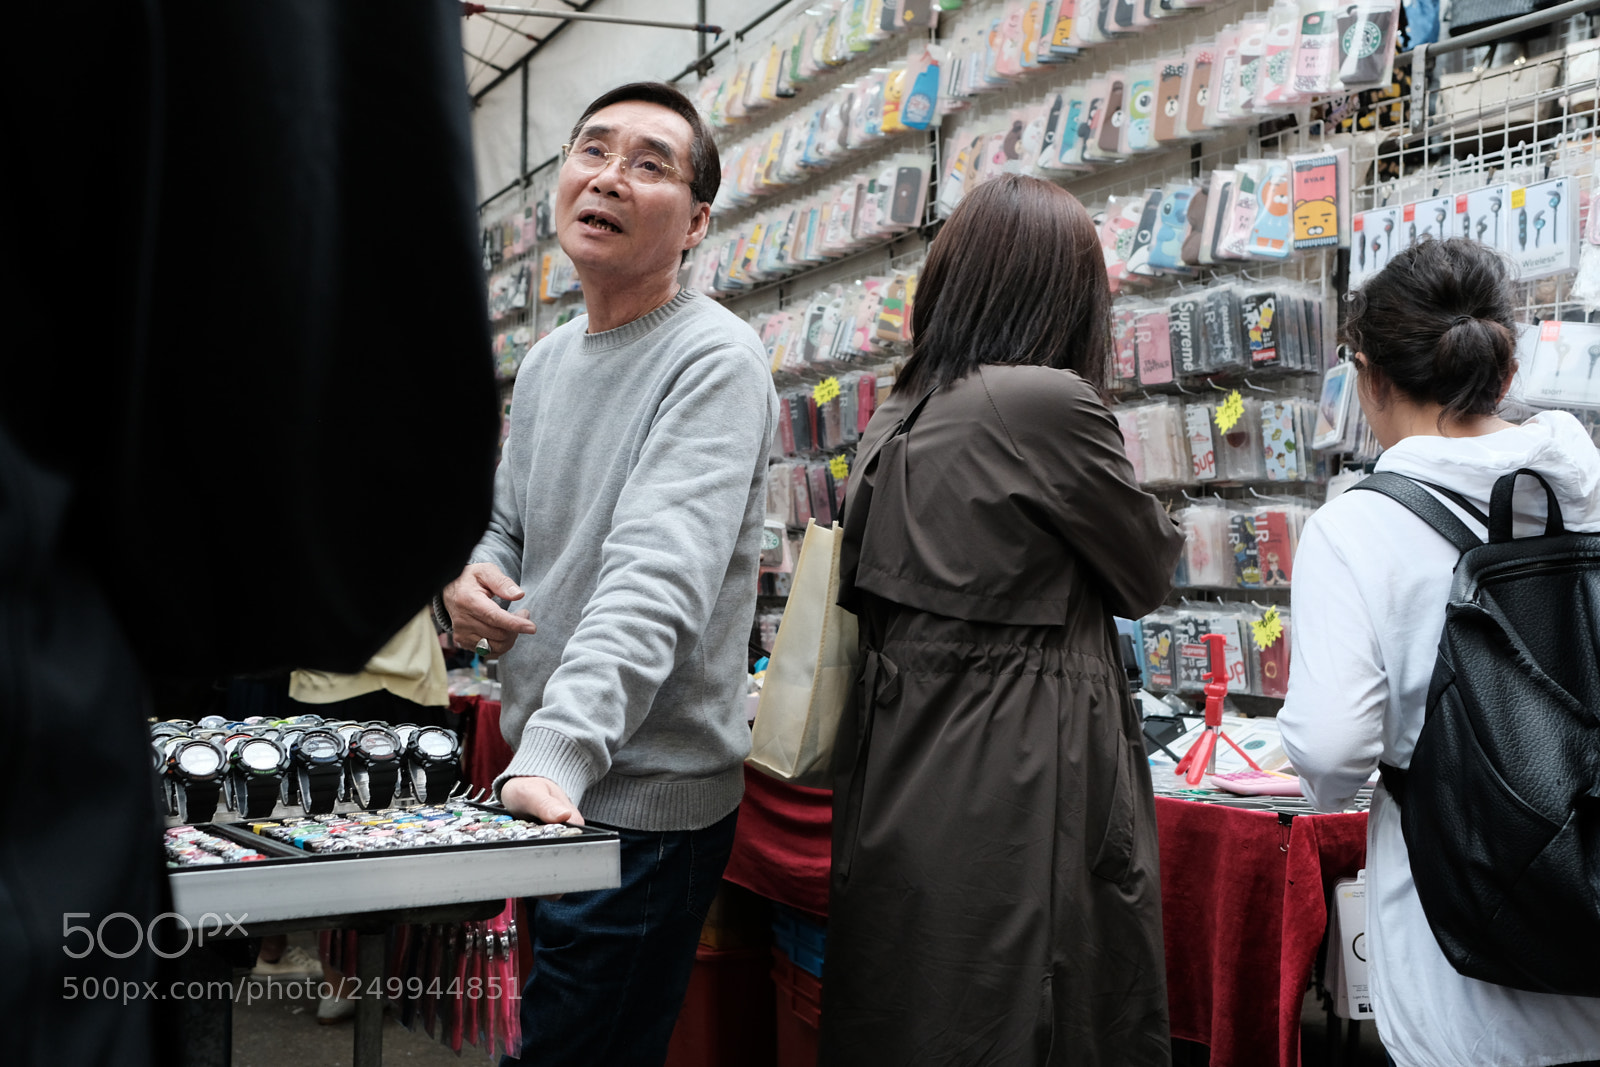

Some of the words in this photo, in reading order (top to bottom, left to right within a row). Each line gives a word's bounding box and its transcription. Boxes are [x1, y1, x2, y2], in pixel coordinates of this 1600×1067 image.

[1521, 256, 1556, 268] Wireless
[1180, 302, 1194, 371] Supreme
[1192, 450, 1215, 476] Sup
[1253, 507, 1270, 543] AIR
[1225, 660, 1245, 685] up
